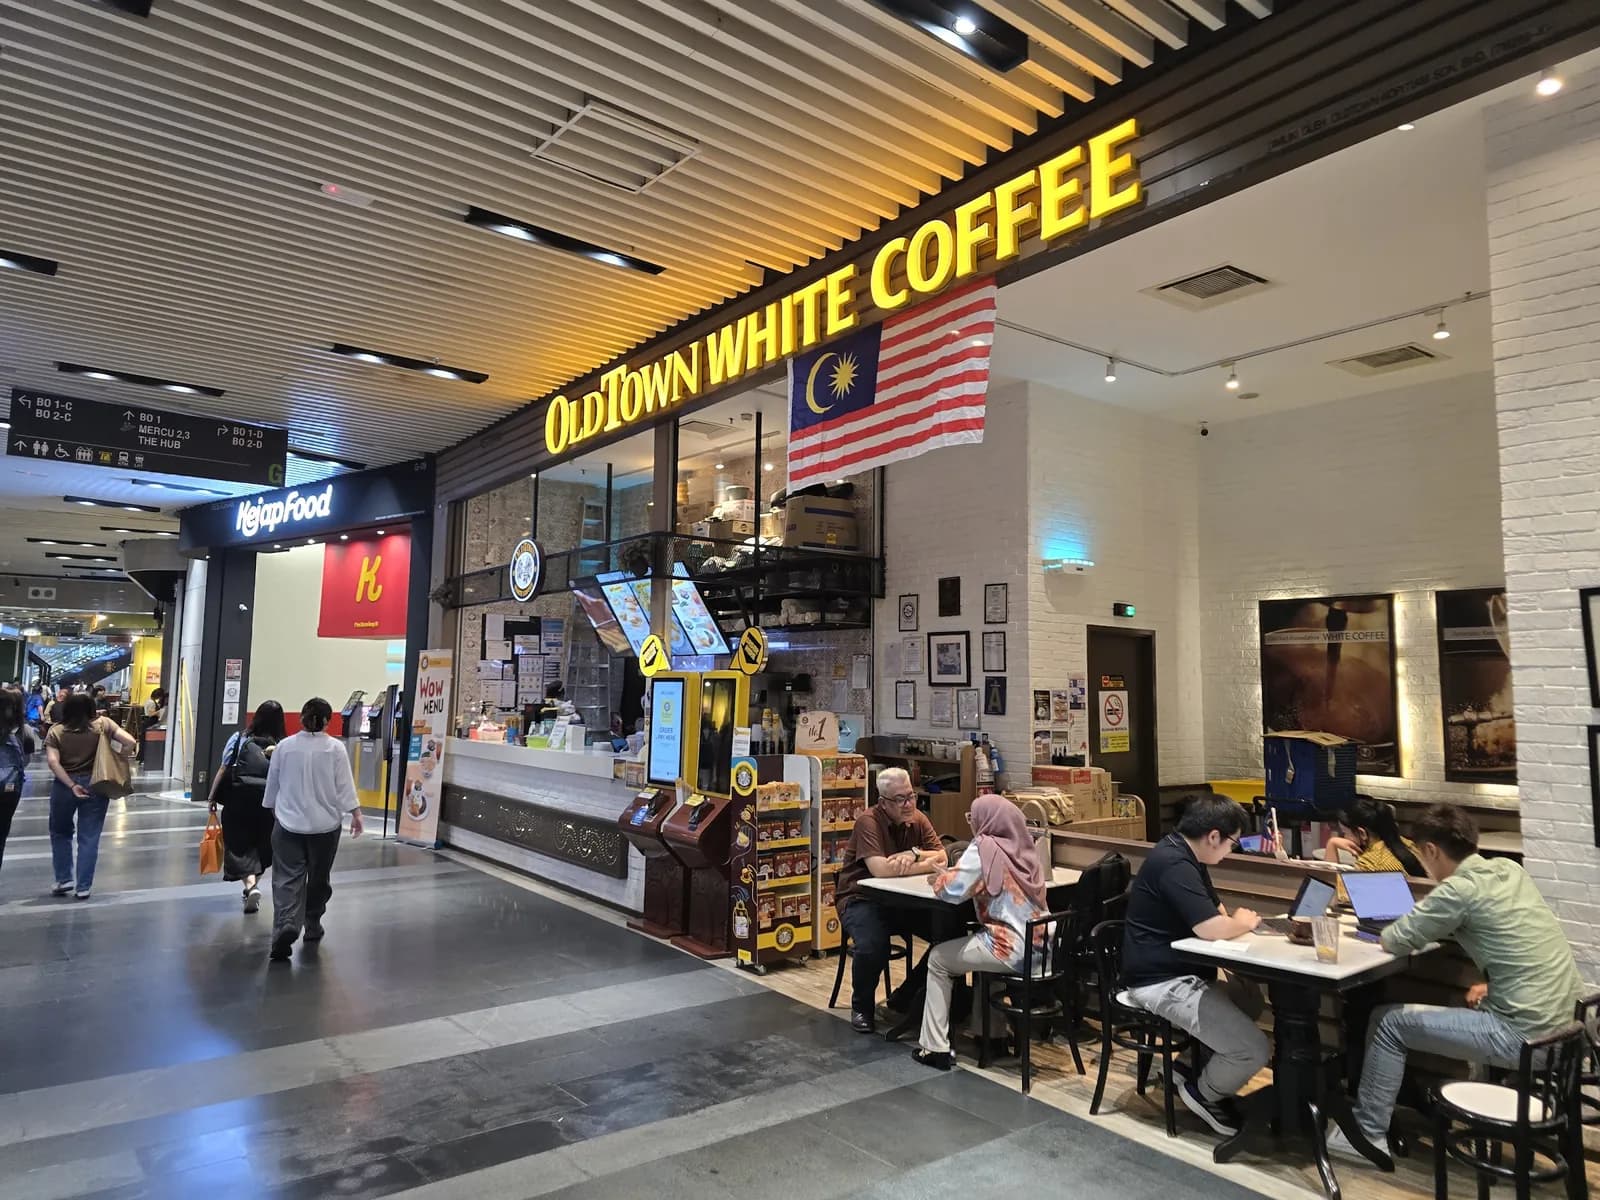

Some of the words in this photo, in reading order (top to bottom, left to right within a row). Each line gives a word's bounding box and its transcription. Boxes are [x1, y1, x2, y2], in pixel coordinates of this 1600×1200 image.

[707, 263, 859, 386] WHITE
[870, 118, 1143, 310] COFFEE
[36, 397, 52, 409] BO
[54, 399, 73, 411] 1-C
[35, 408, 51, 420] BO
[53, 410, 72, 423] 2-C
[139, 412, 154, 423] BO
[156, 414, 162, 424] 1
[138, 424, 176, 438] MERCU
[176, 429, 191, 441] 2,3
[232, 425, 247, 437] BO
[247, 427, 264, 439] 1-D
[138, 435, 157, 448] THE
[159, 437, 181, 450] HUB
[231, 436, 246, 448] BO
[246, 438, 263, 449] 2-D
[267, 463, 283, 485] G
[235, 483, 333, 537] KejapFood
[355, 555, 383, 603] K
[1322, 631, 1350, 641] WHITE
[1352, 630, 1386, 641] COFFEE
[423, 698, 444, 715] MENU
